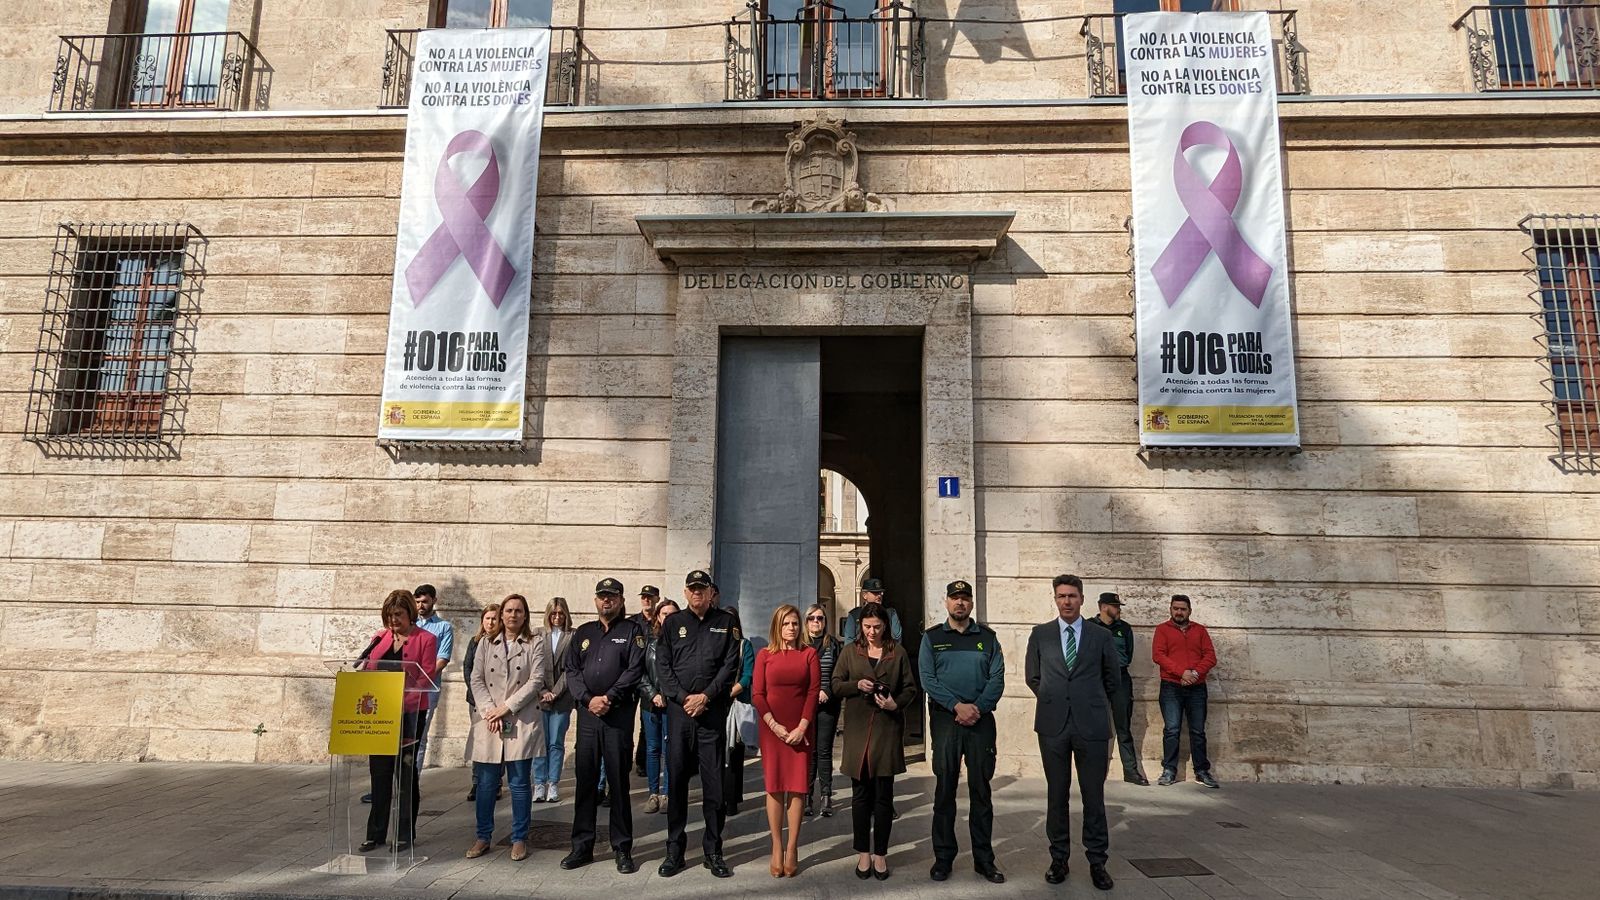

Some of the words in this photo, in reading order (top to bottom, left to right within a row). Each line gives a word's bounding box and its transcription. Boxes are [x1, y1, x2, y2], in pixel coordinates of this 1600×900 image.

[1140, 32, 1157, 45] NO
[1160, 33, 1168, 46] A
[1171, 33, 1187, 45] LA
[1189, 32, 1256, 44] VIOLENCIA
[428, 48, 446, 60] NO
[448, 48, 456, 60] A
[459, 48, 472, 60] LA
[476, 47, 535, 60] VIOLENCIA
[1130, 47, 1180, 60] CONTRA
[1184, 46, 1206, 58] LAS
[1208, 46, 1267, 59] MUJERES
[420, 61, 464, 72] CONTRA
[467, 61, 488, 72] LAS
[490, 59, 542, 72] MUJERES
[1141, 70, 1160, 82] NO
[1163, 70, 1172, 80] A
[1175, 68, 1190, 80] LA
[1192, 67, 1260, 81] VIOLÈNCIA
[424, 82, 442, 94] NO
[444, 82, 452, 93] A
[454, 82, 468, 94] LA
[472, 80, 531, 94] VIOLÈNCIA
[1142, 82, 1191, 96] CONTRA
[1194, 83, 1216, 95] LES
[1220, 81, 1262, 95] DONES
[422, 95, 467, 106] CONTRA
[471, 95, 490, 106] LES
[493, 93, 531, 106] DONES
[684, 273, 818, 290] DELEGACION
[823, 275, 856, 289] DEL
[861, 272, 964, 290] GOBIERNO
[404, 330, 466, 372] #016
[468, 332, 499, 352] PARA
[1160, 330, 1227, 375] #016
[1227, 332, 1263, 352] PARA
[466, 352, 507, 372] TODAS
[1229, 353, 1272, 374] TODAS
[478, 384, 506, 392] mujeres
[1166, 378, 1198, 386] Atención
[1244, 378, 1268, 386] formas
[1246, 388, 1276, 396] mujeres
